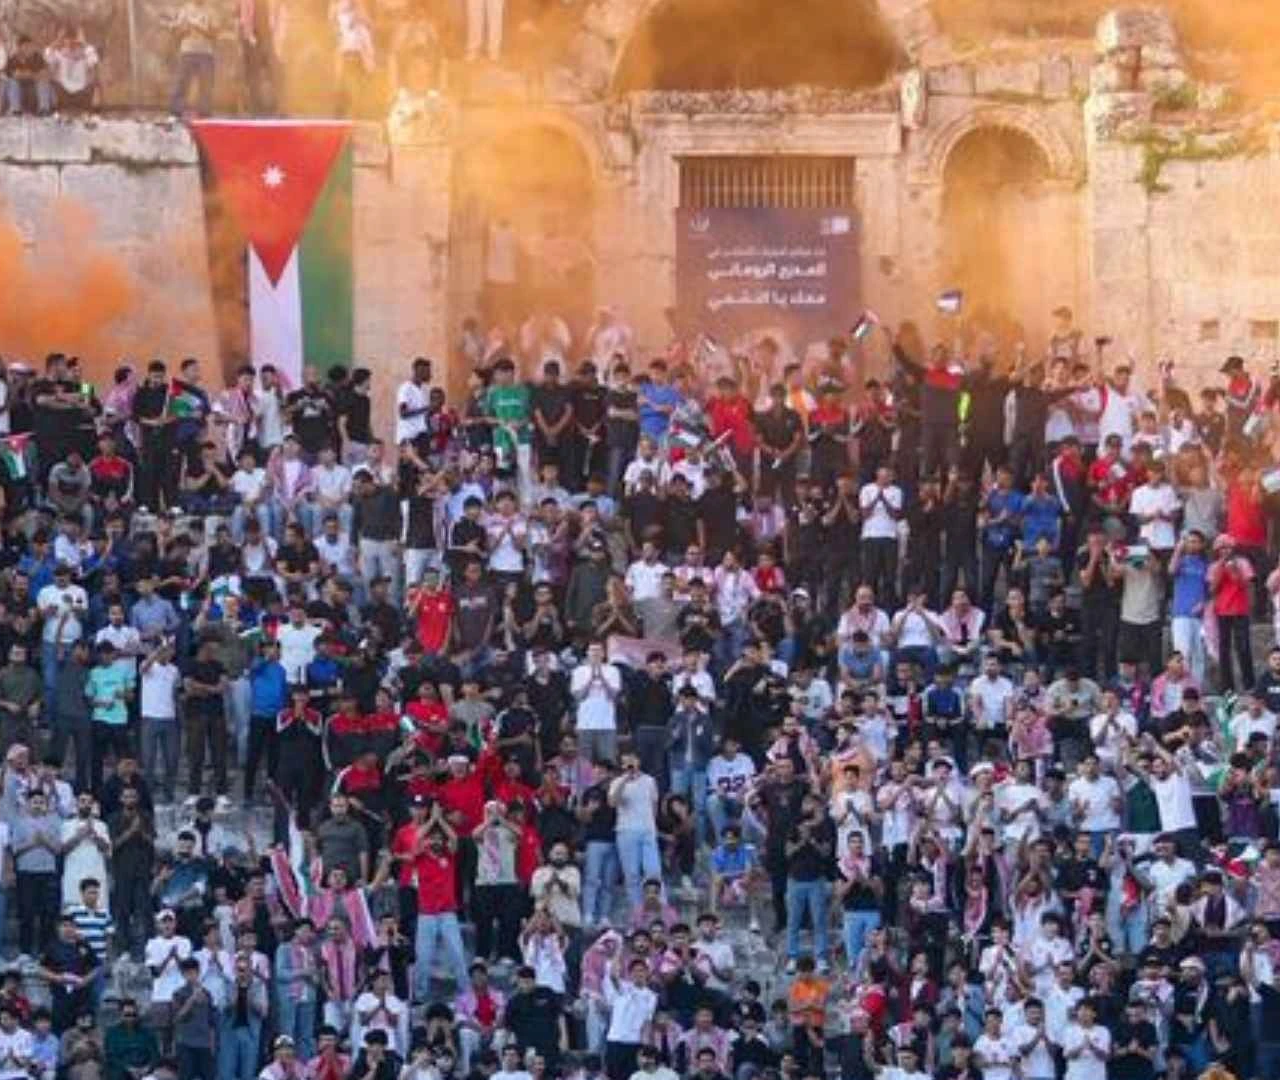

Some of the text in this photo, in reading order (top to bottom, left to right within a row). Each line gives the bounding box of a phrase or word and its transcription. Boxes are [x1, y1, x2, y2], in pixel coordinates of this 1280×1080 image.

[707, 261, 827, 281] المدرج الروماني
[771, 290, 788, 309] يا
